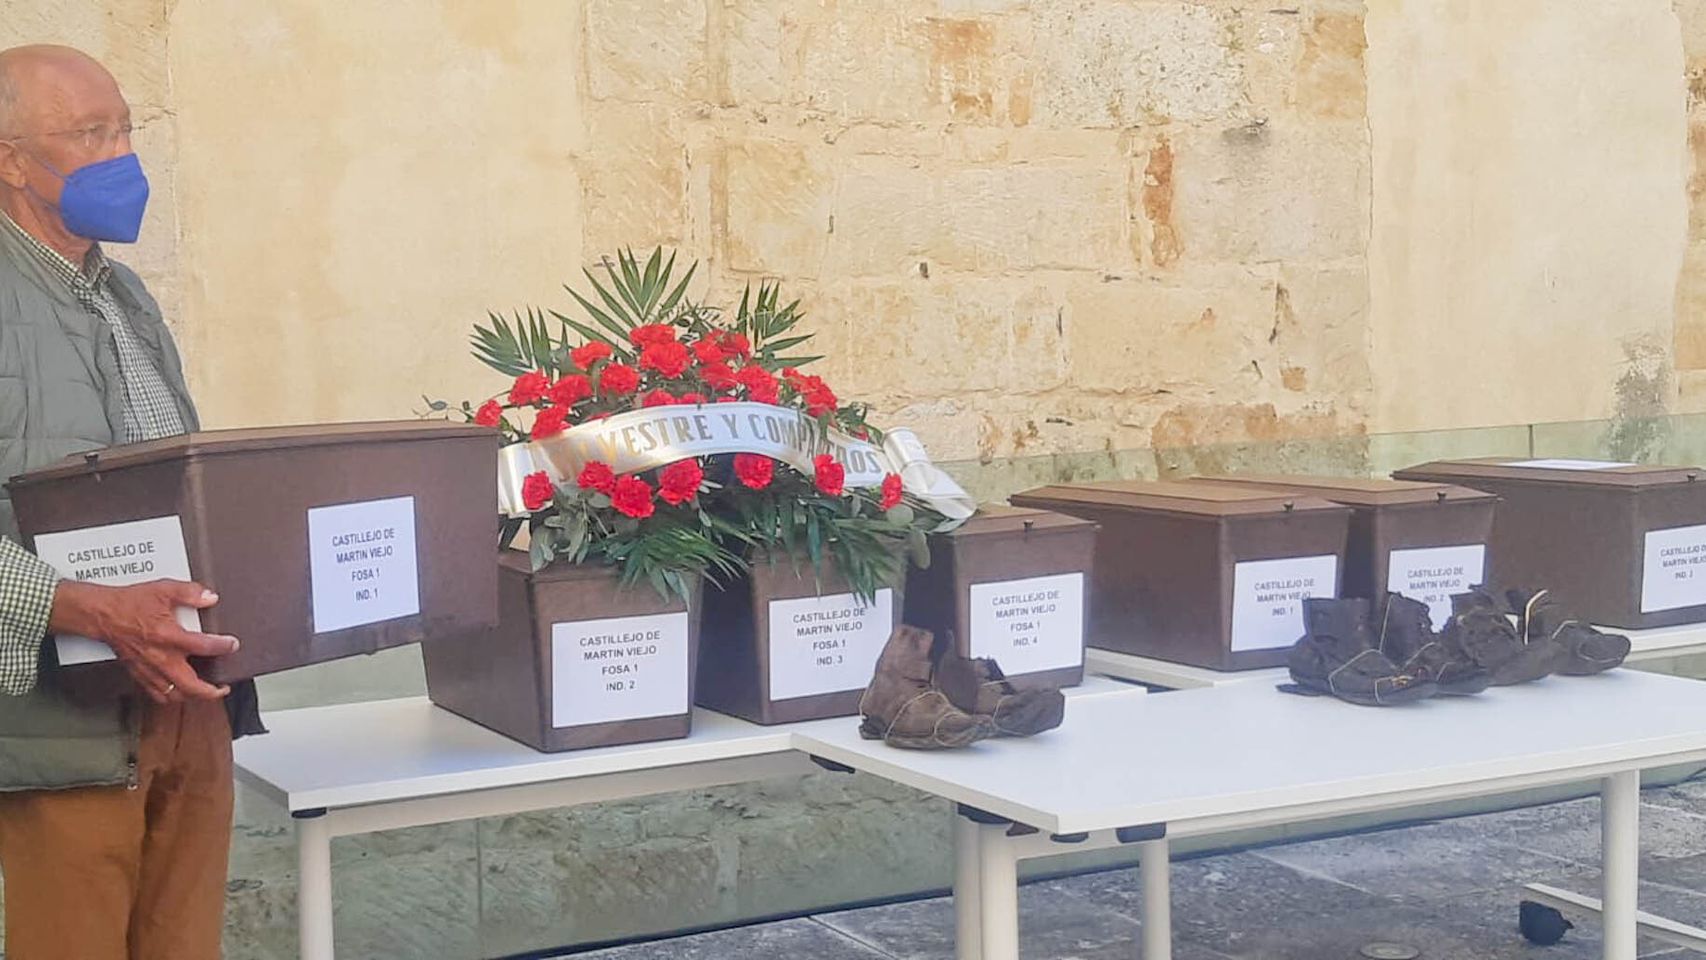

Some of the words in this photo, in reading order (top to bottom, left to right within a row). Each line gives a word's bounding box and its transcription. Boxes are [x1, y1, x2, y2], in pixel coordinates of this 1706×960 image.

[722, 414, 739, 438] Y
[332, 530, 382, 547] CASTILLEJO
[384, 528, 395, 539] DE
[68, 543, 136, 564] CASTILLEJO
[139, 542, 155, 553] DE
[336, 550, 368, 563] MARTIN
[370, 545, 393, 559] VIEJO
[1700, 544, 1706, 552] D
[75, 566, 118, 581] MARTIN
[120, 561, 154, 575] VIEJO
[352, 568, 374, 581] FOSA
[376, 567, 381, 578] 1
[1254, 579, 1302, 591] CASTILLEJO
[1303, 578, 1315, 588] DE
[374, 588, 379, 598] 1
[992, 592, 1045, 606] CASTILLEJO
[1047, 590, 1060, 600] DE
[1257, 593, 1287, 602] MARTIN
[1288, 591, 1311, 600] VIEJO
[793, 609, 851, 624] CASTILLEJO
[853, 607, 866, 617] DE
[996, 607, 1029, 618] MARTIN
[1031, 604, 1056, 614] VIEJO
[797, 625, 833, 637] MARTIN
[835, 621, 863, 632] VIEJO
[1010, 622, 1034, 632] FOSA
[1036, 620, 1040, 629] 1
[580, 632, 644, 647] CASTILLEJO
[646, 630, 661, 640] DE
[813, 640, 839, 651] FOSA
[841, 639, 846, 648] 1
[1033, 636, 1038, 644] 4
[584, 649, 624, 661] MARTIN
[626, 645, 657, 656] VIEJO
[838, 655, 843, 664] 3
[602, 664, 630, 675] FOSA
[634, 663, 638, 673] 1
[629, 680, 635, 689] 2
